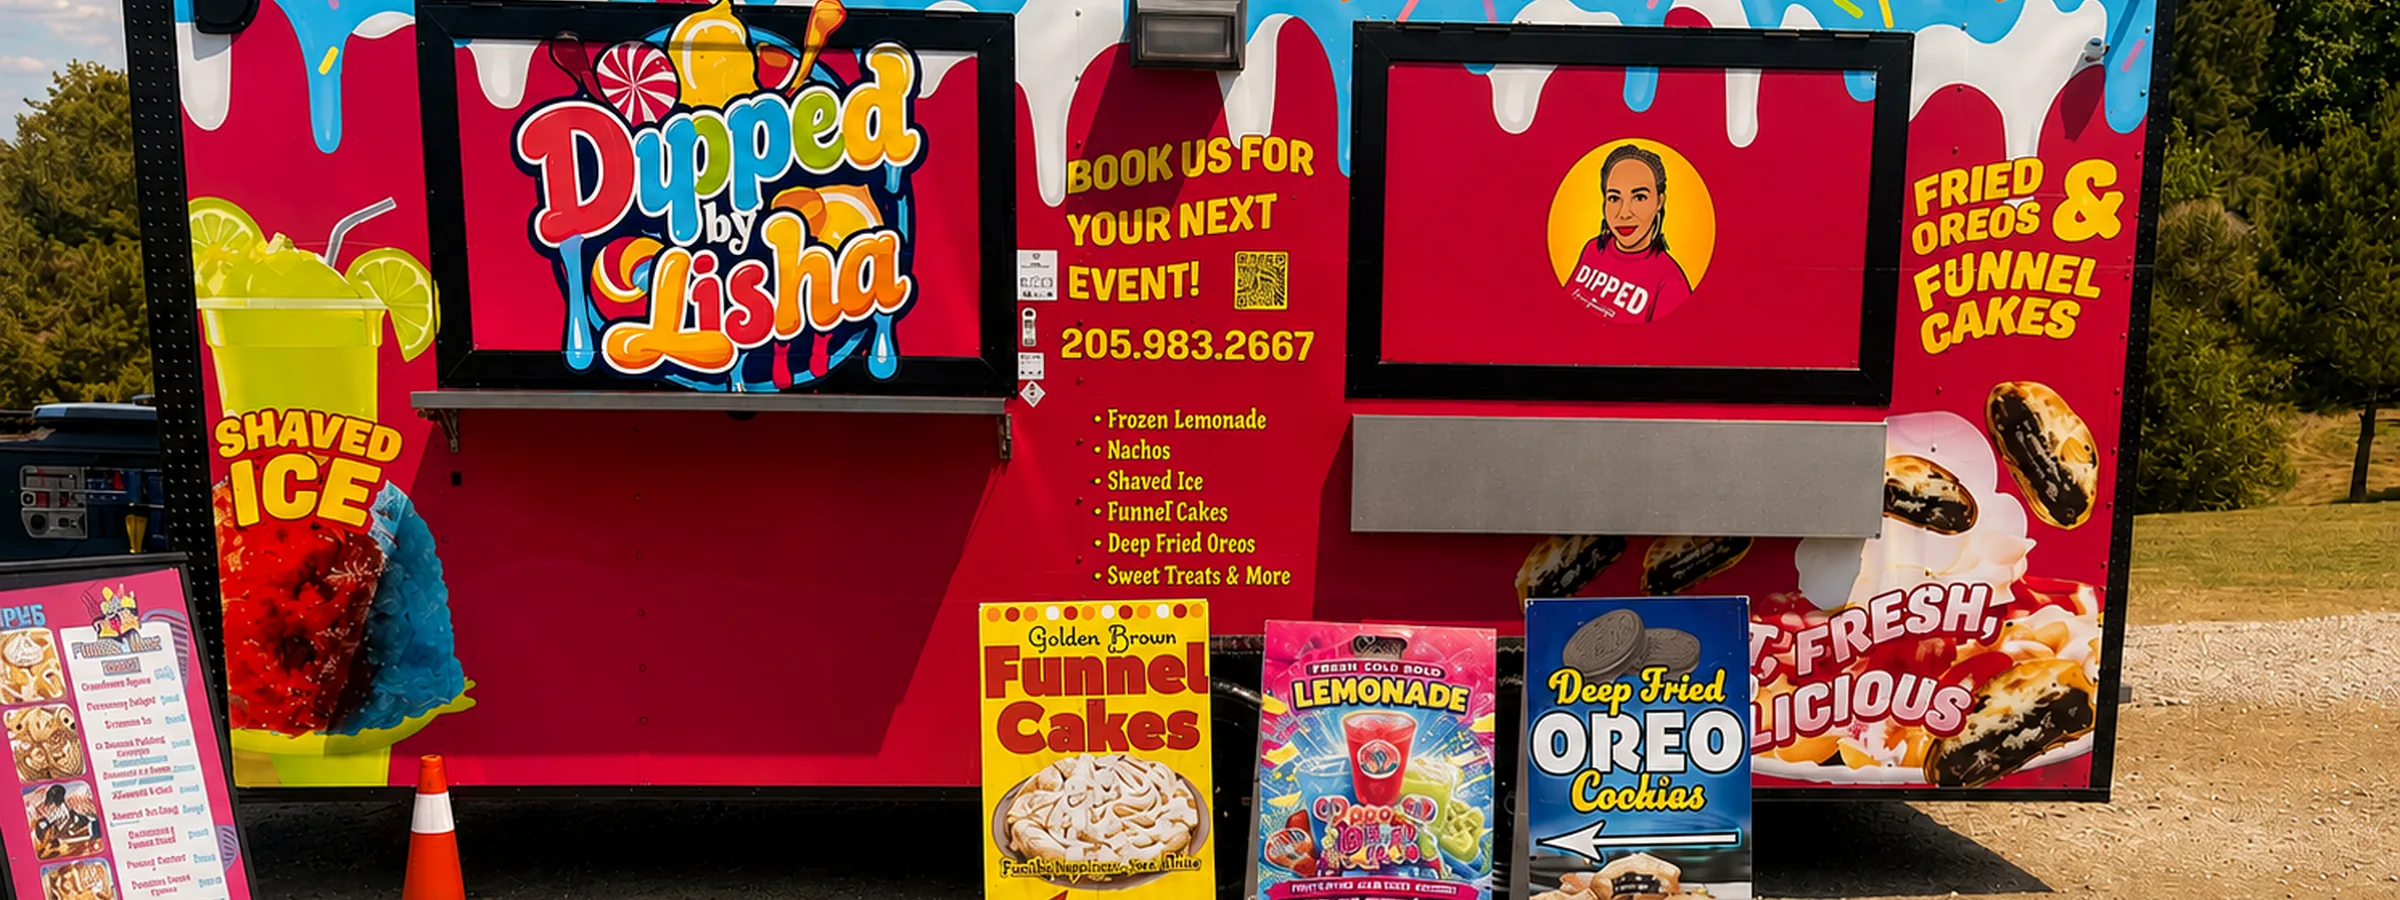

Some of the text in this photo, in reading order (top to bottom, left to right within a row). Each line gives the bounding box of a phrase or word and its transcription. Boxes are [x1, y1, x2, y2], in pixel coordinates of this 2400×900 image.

[517, 41, 922, 247] Dipped
[1068, 136, 1314, 194] BOOK US FOR
[1914, 157, 2044, 216] FRIED
[2053, 159, 2124, 242] &
[705, 203, 758, 254] by
[1066, 193, 1278, 247] YOUR NEXT
[1912, 201, 2041, 255] OREOS
[602, 212, 912, 374] Lisha
[1069, 261, 1200, 302] EVENT!
[1575, 265, 1649, 315] DIPPED
[1913, 250, 2101, 312] FUNNEL
[1061, 328, 1315, 361] 205.983.2667
[1920, 295, 2081, 354] CAKES
[215, 409, 404, 463] SHAVED
[1107, 407, 1267, 429] Frozen Lemonade
[1107, 438, 1171, 460] Nachos
[230, 454, 382, 527] ICE
[1107, 469, 1204, 491] Shaved Ice
[1107, 500, 1228, 522] Funnel Cakes
[1107, 531, 1256, 558] Deep Fried Oreos
[1107, 565, 1291, 586] Sweet Treats & More
[1029, 624, 1177, 653] Golden Brown
[1796, 584, 1998, 677] FRESH,
[984, 641, 1208, 699] Funnel
[1292, 676, 1469, 712] LEMONADE
[1548, 666, 1726, 716] Deep Fried
[997, 698, 1200, 754] Cakes
[1750, 670, 1972, 748] LICIOUS
[1532, 711, 1743, 774] OREO
